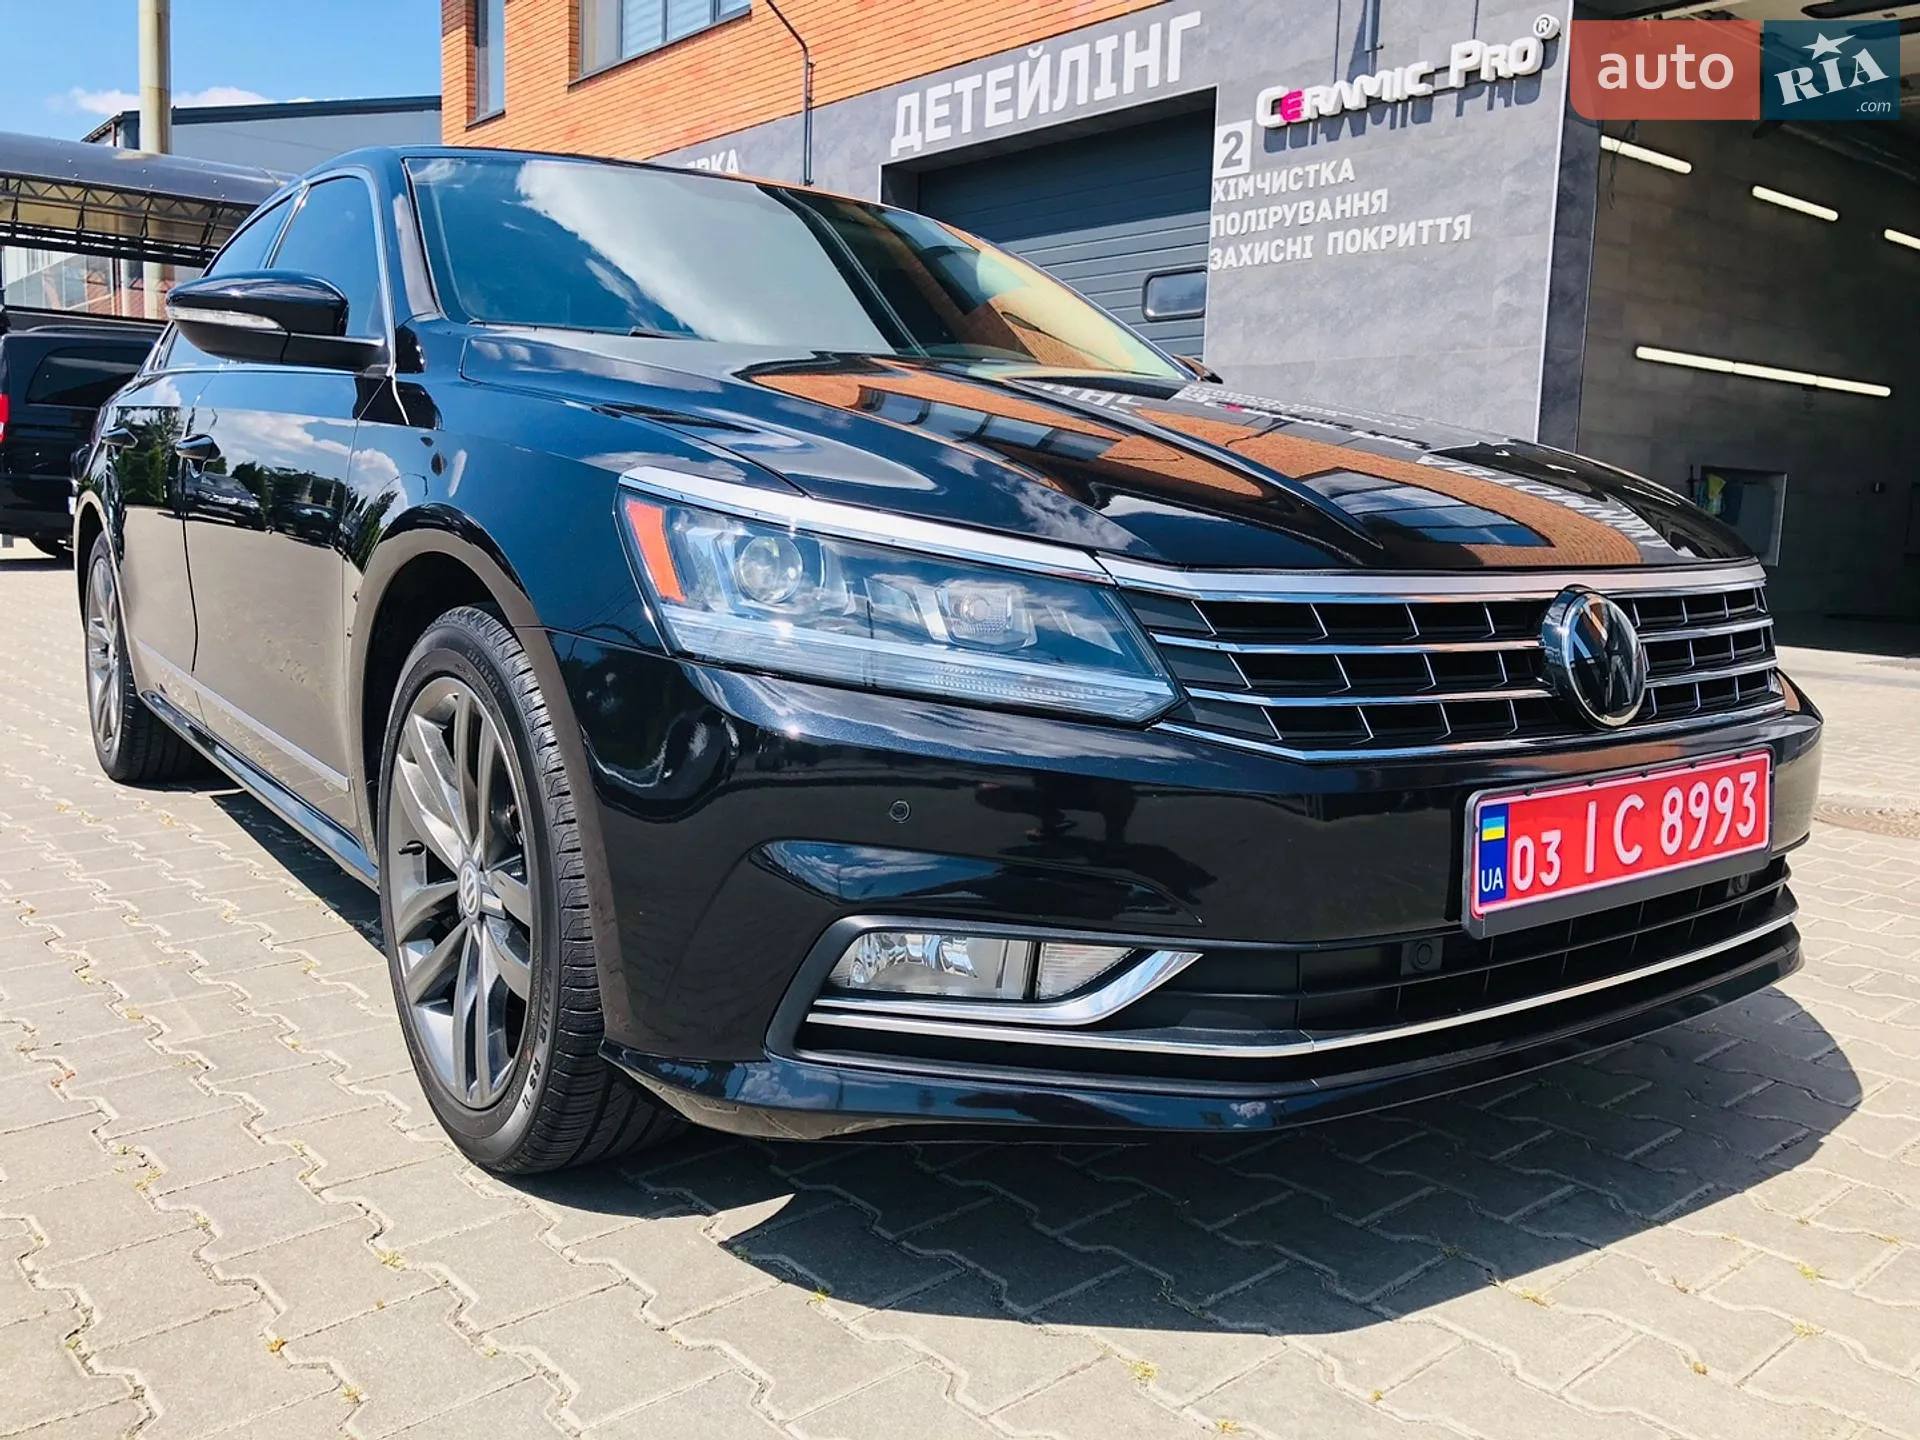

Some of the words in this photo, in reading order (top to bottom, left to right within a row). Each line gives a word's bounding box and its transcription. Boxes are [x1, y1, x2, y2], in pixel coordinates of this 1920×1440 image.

[890, 11, 1202, 157] ДЕТЕЙЛІНГ
[1220, 129, 1245, 171] 2
[1213, 158, 1355, 203] ХІМЧИСТКА
[1212, 188, 1388, 239] ПОЛІРУВАННЯ
[1210, 235, 1314, 271] ЗАХИСНІ
[1327, 214, 1472, 256] ПОКРИТТЯ
[1512, 829, 1562, 891] 03
[1659, 771, 1758, 856] 8993
[1481, 867, 1504, 893] UA
